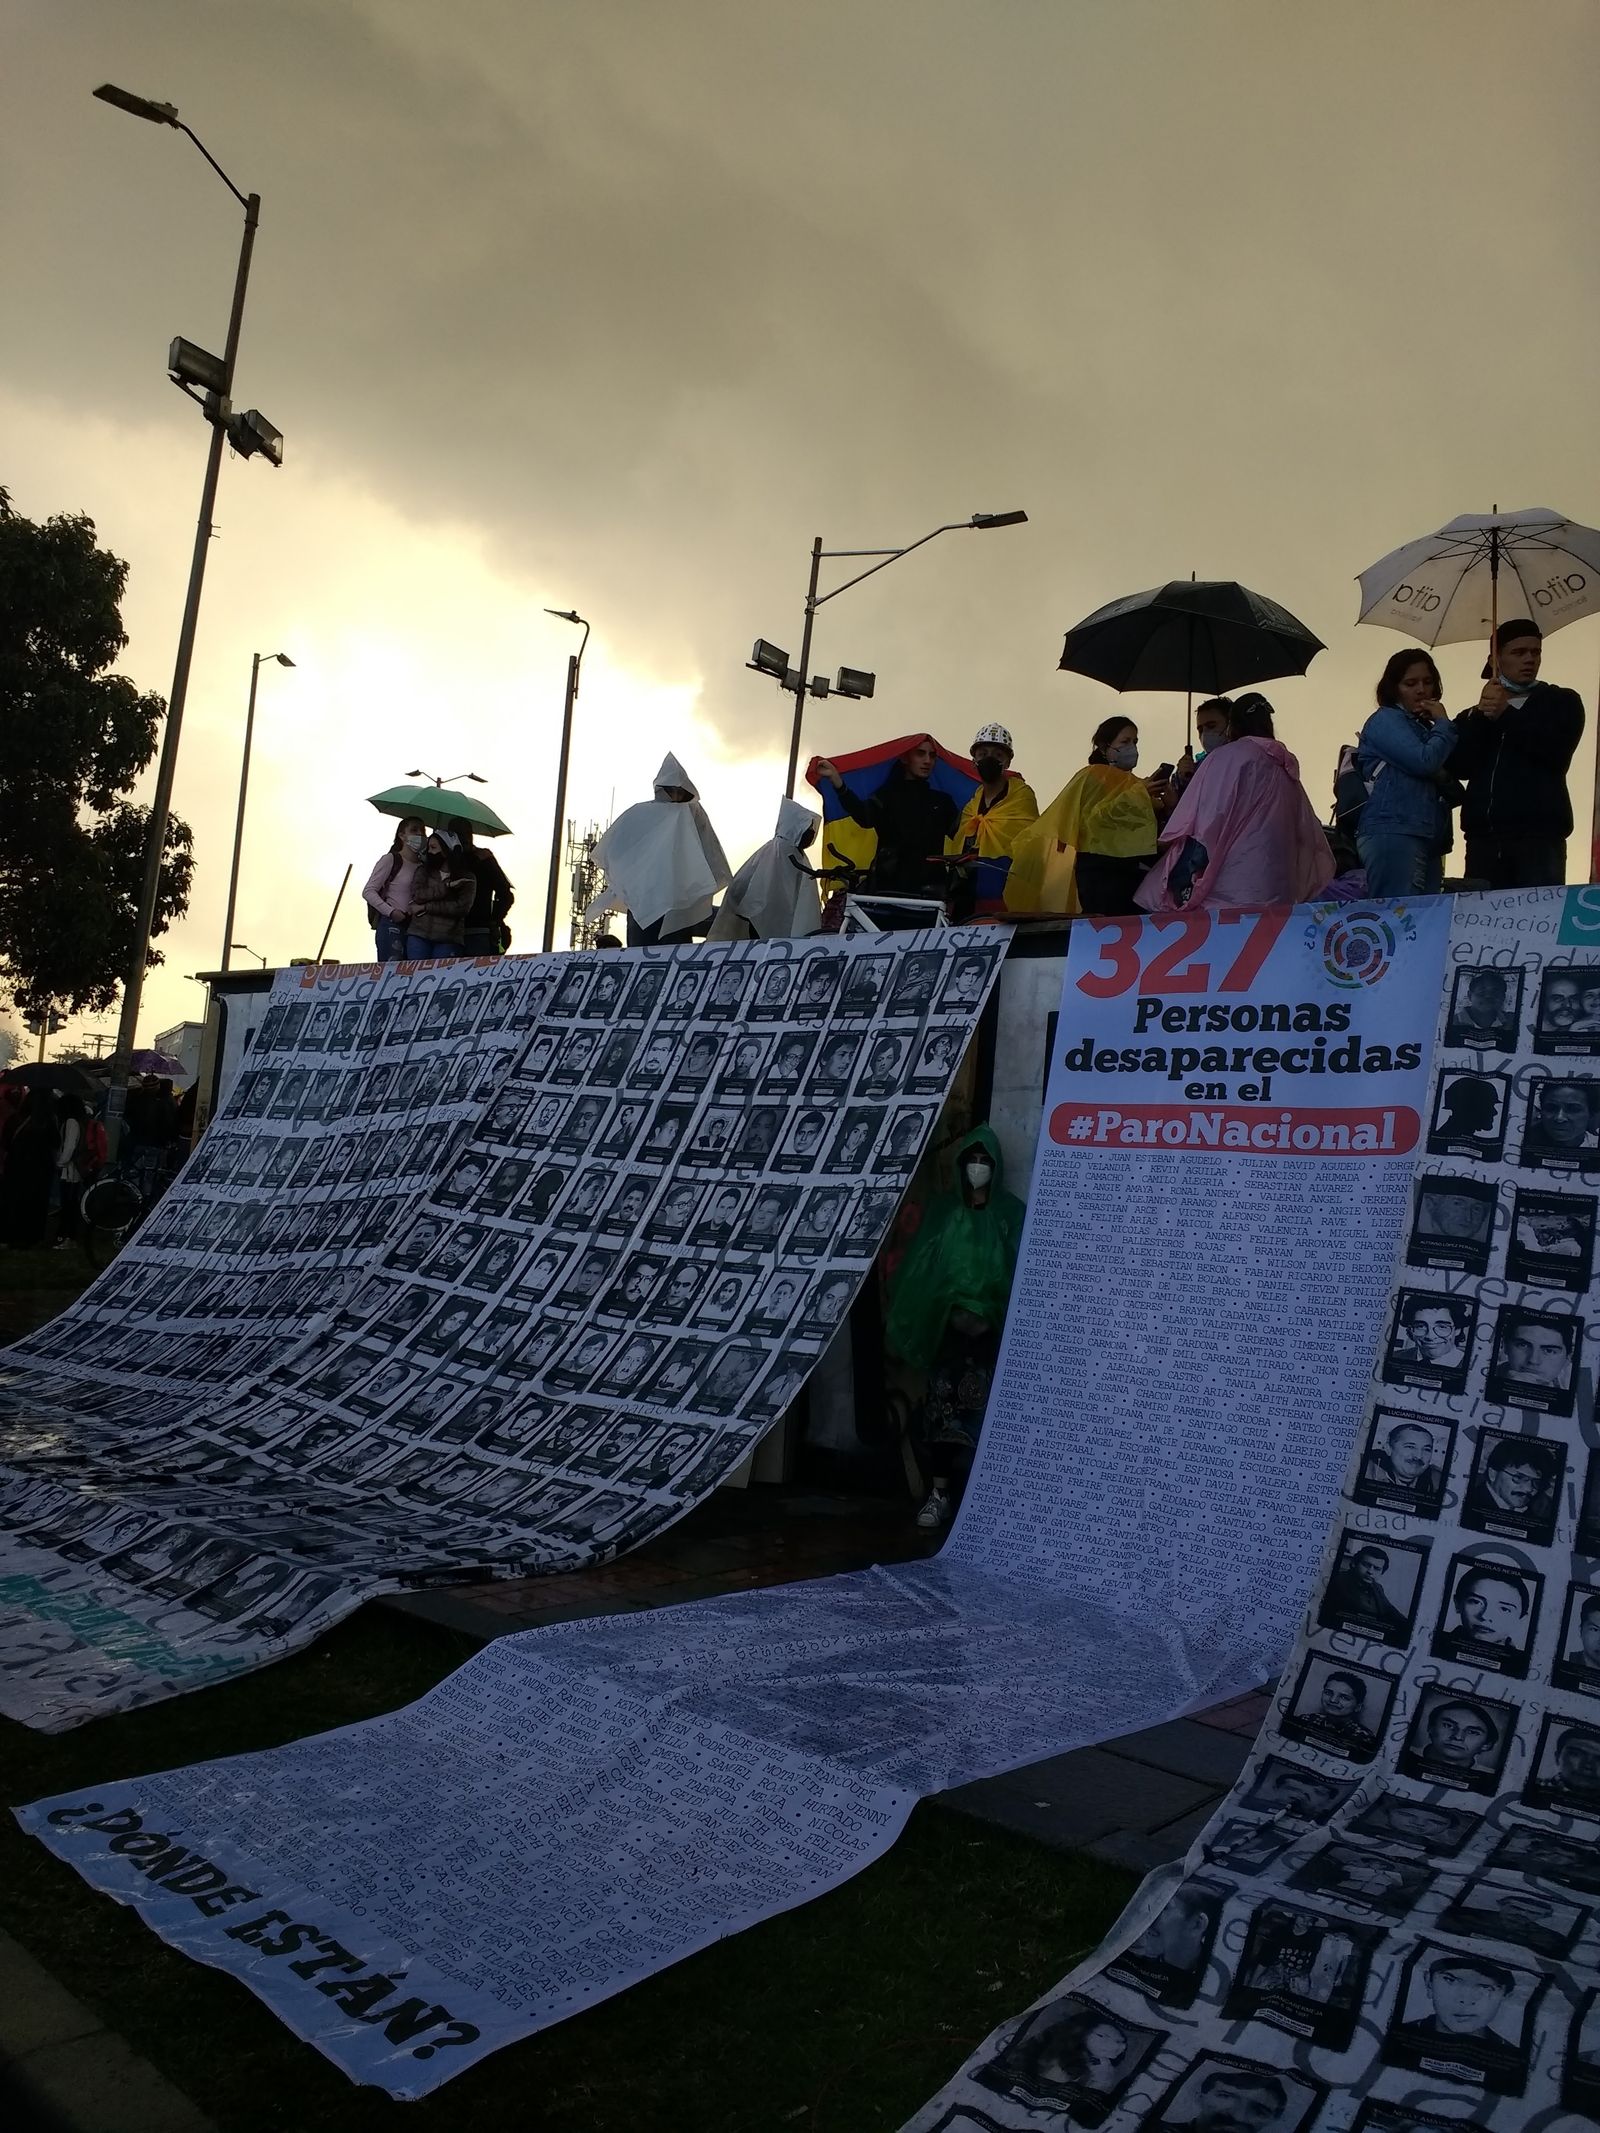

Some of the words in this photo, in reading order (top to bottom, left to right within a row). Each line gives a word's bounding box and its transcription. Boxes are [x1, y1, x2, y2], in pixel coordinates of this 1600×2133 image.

[1075, 905, 1293, 999] 327
[1132, 998, 1352, 1034] Personas
[1064, 1035, 1422, 1081] desaparecidas
[1184, 1079, 1228, 1100] en
[1237, 1077, 1272, 1102] el
[1066, 1109, 1396, 1151] #ParoNacional
[1042, 1160, 1081, 1169] AGUDELO
[1088, 1162, 1131, 1172] VELANDIA
[1150, 1165, 1179, 1174] KEVIN
[1186, 1167, 1228, 1176] AGUILAR
[1250, 1170, 1310, 1181] FRANCISCO
[1315, 1173, 1360, 1181] AHUMADA
[1044, 1150, 1065, 1158] SARA
[1070, 1152, 1093, 1160] ABAD
[1136, 1154, 1175, 1163] ESTEBAN
[1180, 1156, 1222, 1165] AGUDELO
[1239, 1159, 1277, 1168] JULIAN
[1283, 1161, 1316, 1170] DAVID
[1320, 1162, 1365, 1170] AGUDELO
[1039, 1179, 1077, 1188] ALZARSE
[1093, 1183, 1120, 1192] ANGIE
[1125, 1185, 1153, 1193] AMAYA
[1170, 1187, 1199, 1195] RONAL
[1204, 1189, 1241, 1198] ANDREY
[1260, 1192, 1304, 1202] VALERIA
[1310, 1195, 1342, 1203] ANGEL
[1361, 1196, 1406, 1204] JEREMIA
[1040, 1169, 1078, 1179] ALEGRIA
[1085, 1172, 1123, 1181] CAMACHO
[1142, 1175, 1176, 1184] CAMILO
[1182, 1177, 1224, 1186] ALEGRIA
[1244, 1180, 1302, 1191] SEBASTIAN
[1308, 1184, 1353, 1192] ALVAREZ
[1036, 1198, 1058, 1207] ARCE
[1078, 1202, 1128, 1212] SEBASTIAN
[1134, 1206, 1157, 1214] ARCE
[1179, 1208, 1214, 1218] VICTOR
[1222, 1212, 1266, 1222] ALFONSO
[1274, 1215, 1312, 1225] ARCILA
[1321, 1217, 1347, 1226] RAVE
[1372, 1219, 1403, 1228] LIZET
[1037, 1188, 1070, 1198] ARAGON
[1074, 1192, 1113, 1201] BARCELO
[1126, 1195, 1177, 1205] ALEJANDRO
[1180, 1198, 1217, 1208] ARANGO
[1232, 1201, 1270, 1211] ANDRES
[1274, 1204, 1313, 1214] ARANGO
[1328, 1207, 1361, 1215] ANGIE
[1366, 1207, 1405, 1216] VANESS
[1033, 1218, 1092, 1230] ARISTIZABAL
[1111, 1225, 1150, 1235] NICOLAS
[1156, 1228, 1186, 1238] ARIZA
[1205, 1232, 1242, 1242] ANDRES
[1250, 1234, 1288, 1245] FELIPE
[1294, 1239, 1346, 1249] ARROYAVE
[1354, 1241, 1394, 1250] CHACON
[1034, 1208, 1072, 1218] AREVALO
[1091, 1213, 1124, 1223] FELIPE
[1130, 1216, 1158, 1225] ARIAS
[1177, 1219, 1212, 1229] MAICOL
[1219, 1222, 1250, 1232] ARIAS
[1258, 1225, 1309, 1236] VALENCIA
[1330, 1229, 1368, 1238] MIGUEL
[1022, 1278, 1044, 1287] JUAN
[1048, 1281, 1093, 1293] BUITRAGO
[1109, 1288, 1144, 1298] ANDRES
[1149, 1292, 1184, 1302] CAMILO
[1190, 1296, 1226, 1307] BUSTOS
[1244, 1301, 1288, 1313] ANELLIS
[1294, 1306, 1346, 1318] CABARCAS
[1366, 1311, 1386, 1320] JOH
[999, 1390, 1049, 1404] SEBASTIAN
[1053, 1398, 1098, 1412] CORREDOR
[1113, 1406, 1143, 1419] DIANA
[1149, 1413, 1171, 1423] CRUZ
[1188, 1419, 1238, 1433] SANTIAGO
[1243, 1427, 1268, 1438] CRUZ
[1286, 1433, 1326, 1446] SERGIO
[987, 1441, 1026, 1454] ESTEBAN
[1078, 1457, 1118, 1470] NICOLAS
[1175, 1474, 1200, 1485] JUAN
[1205, 1479, 1237, 1492] DAVID
[1242, 1485, 1280, 1499] FLOREZ
[1286, 1493, 1319, 1505] SERNA
[847, 1801, 892, 1827] JENNY
[222, 1907, 481, 2060] ESTÁN?
